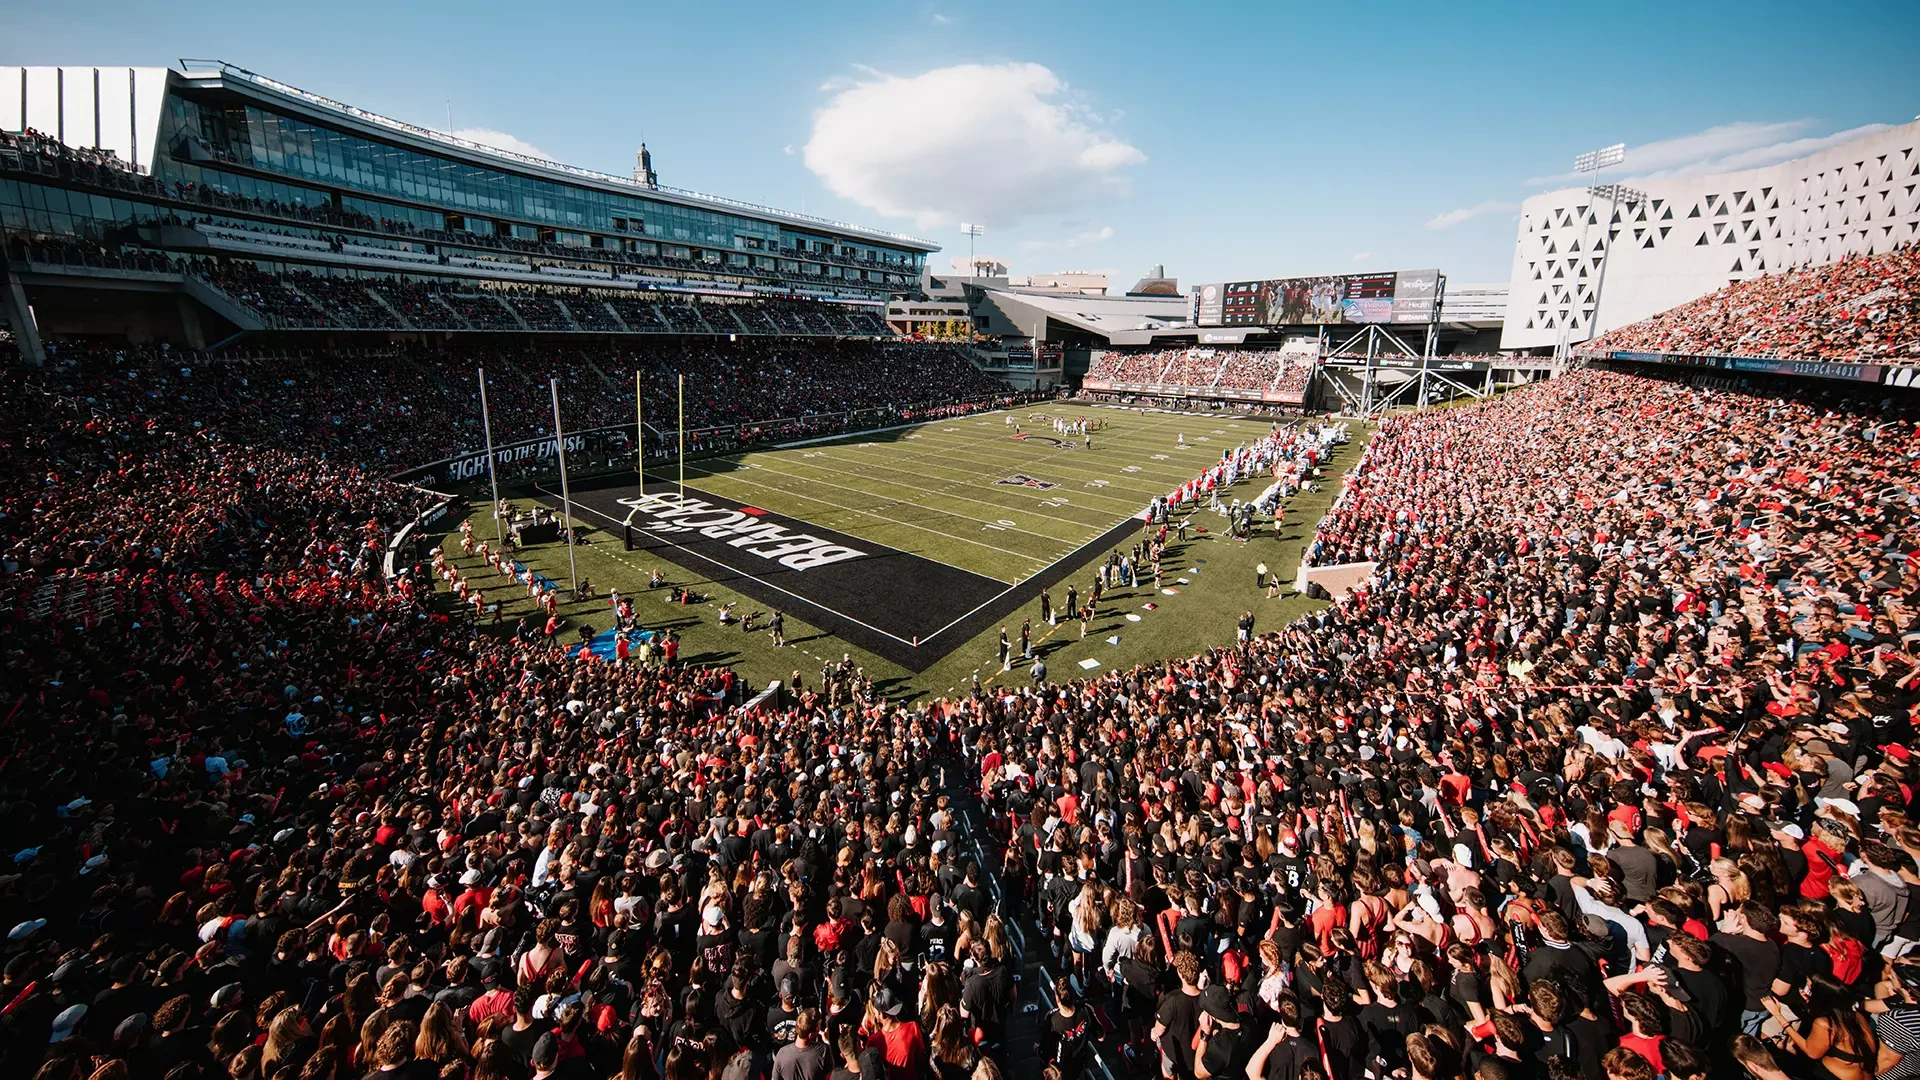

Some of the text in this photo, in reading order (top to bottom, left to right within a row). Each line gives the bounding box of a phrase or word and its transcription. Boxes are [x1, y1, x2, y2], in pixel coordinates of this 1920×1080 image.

[1226, 297, 1234, 305] 17
[1794, 362, 1861, 378] 513-PCA-401K
[450, 435, 586, 481] FIGHT TO THE FINISH
[1038, 497, 1069, 507] 20
[981, 519, 1016, 531] 10
[616, 492, 869, 571] BEARCATS
[1001, 788, 1008, 799] 5
